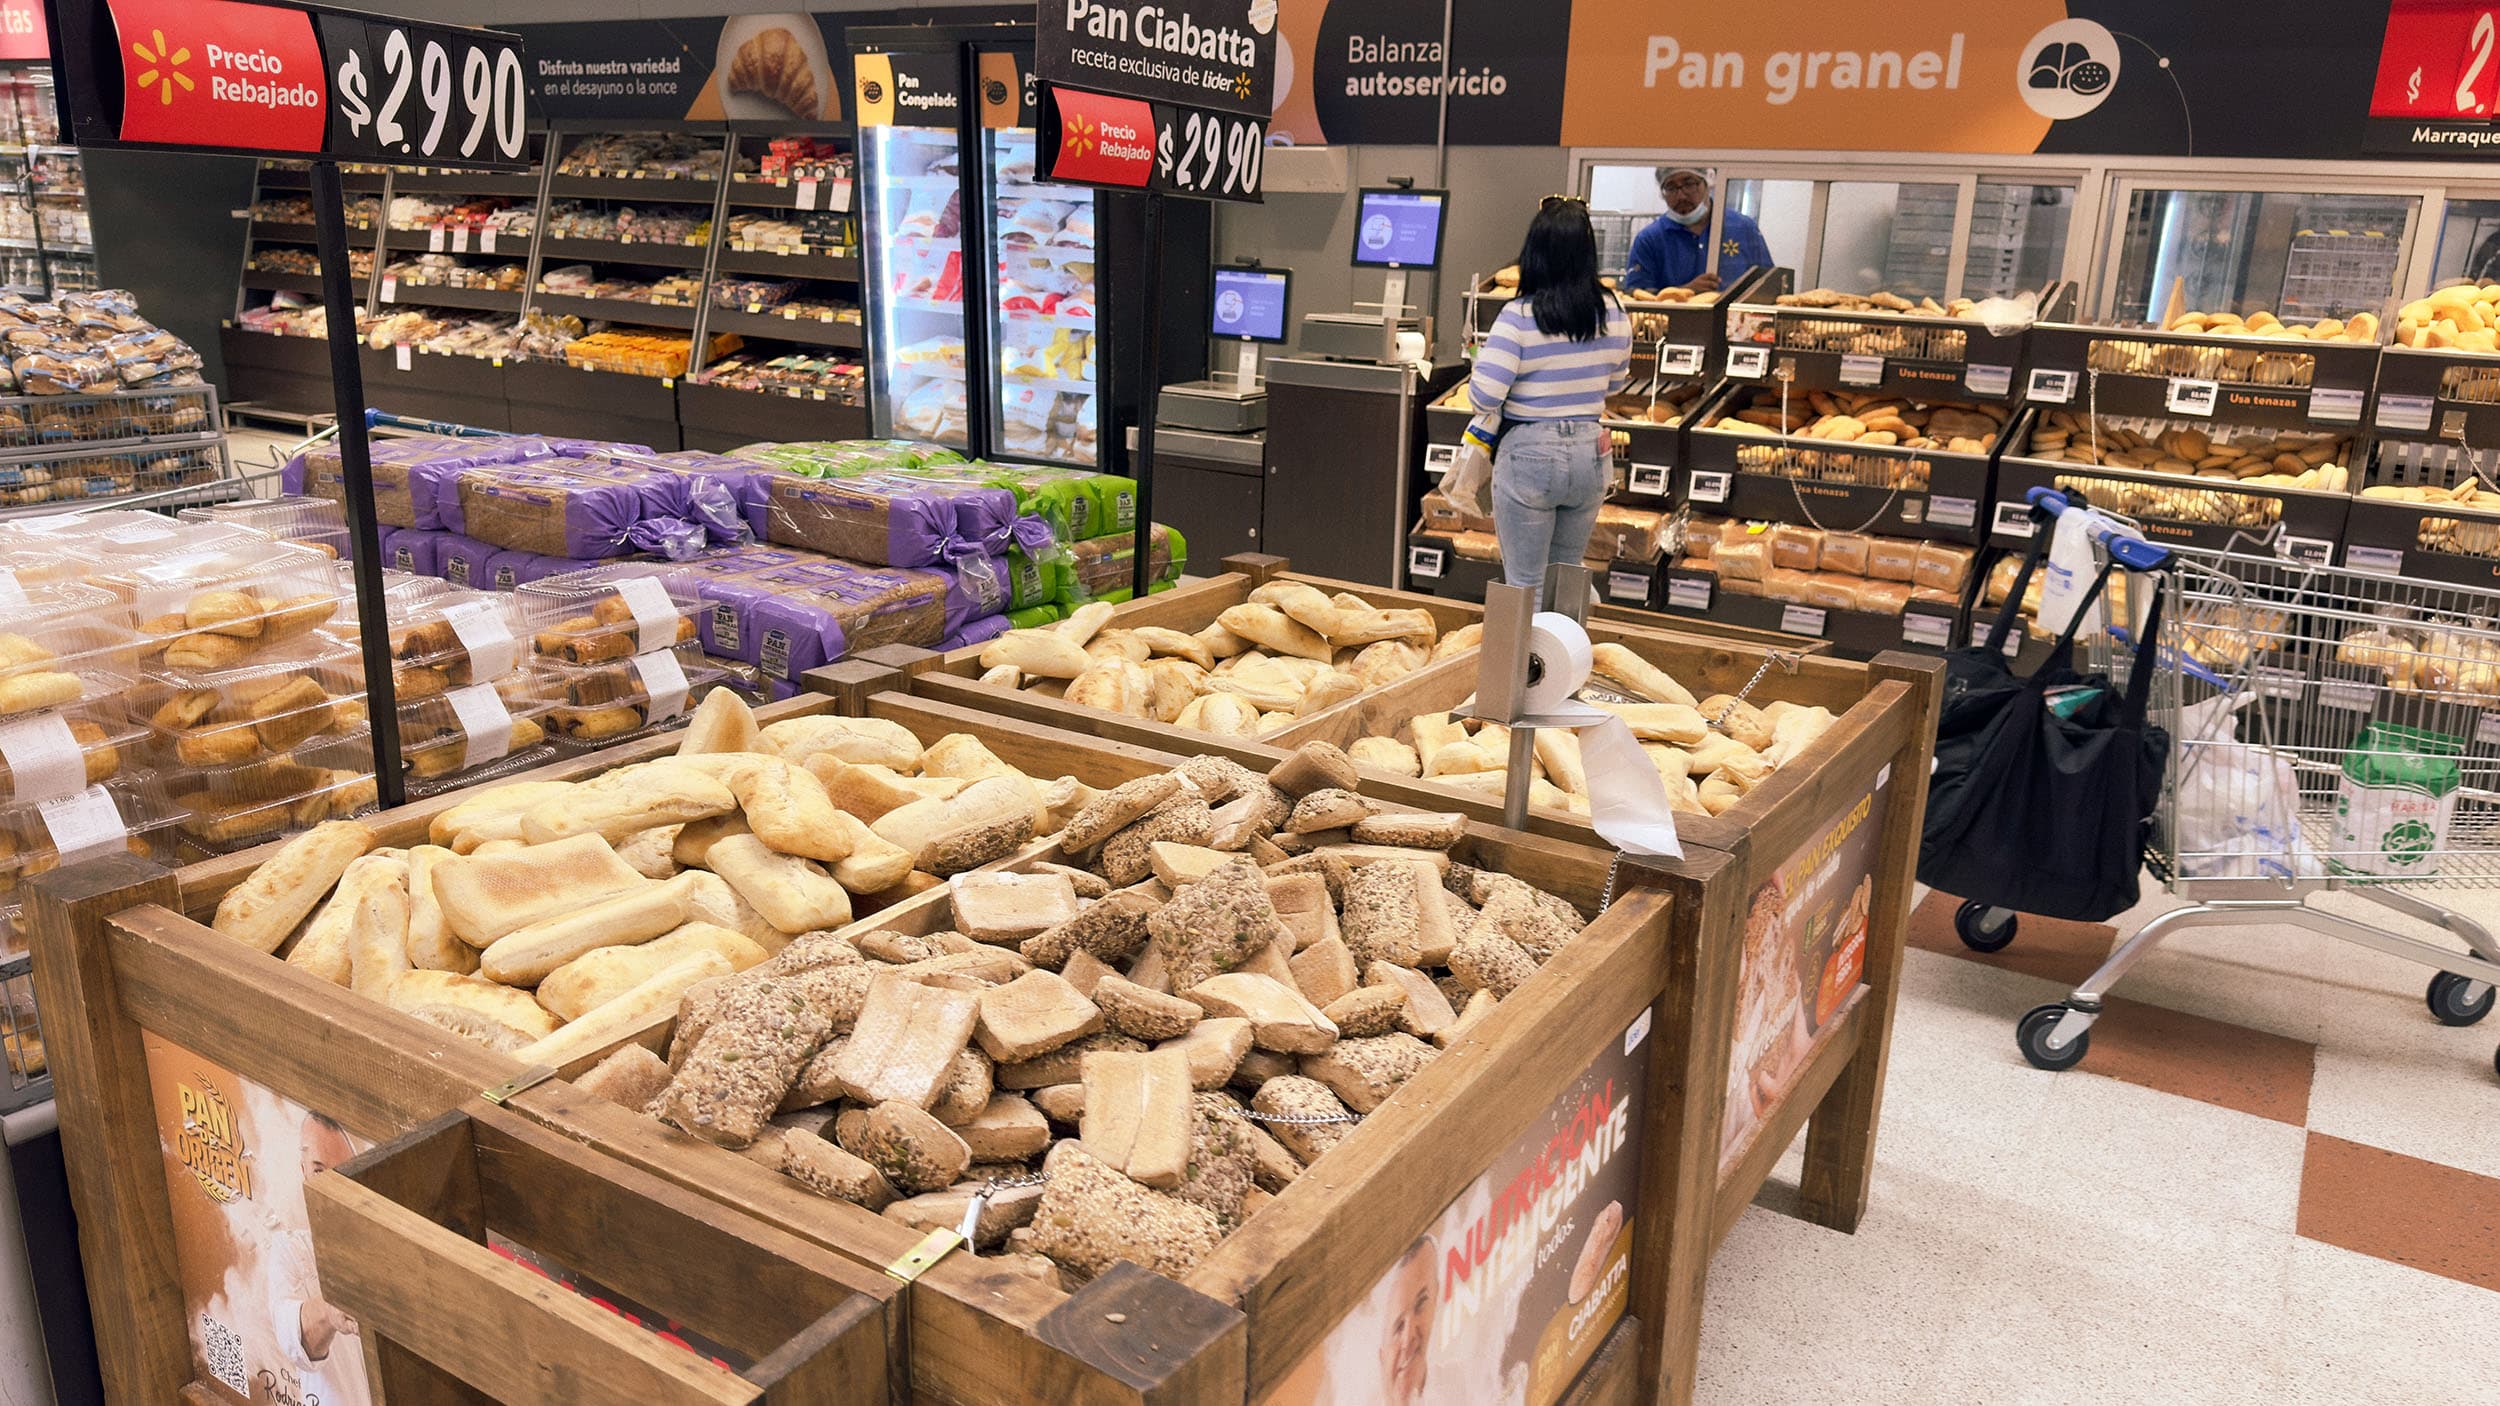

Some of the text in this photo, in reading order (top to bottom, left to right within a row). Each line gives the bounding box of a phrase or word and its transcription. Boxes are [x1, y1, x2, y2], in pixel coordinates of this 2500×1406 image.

[1066, 0, 1256, 67] Pan Ciabatta
[1348, 35, 1442, 63] Balanza
[206, 44, 282, 74] Precio
[539, 57, 681, 75] Disfruta nuestra variedad
[1071, 47, 1117, 70] receta
[1119, 58, 1180, 83] exclusiva
[1182, 65, 1199, 86] de
[1644, 32, 1965, 105] Pan granel
[212, 76, 318, 108] Rebajado
[338, 28, 525, 158] $2.990
[545, 79, 678, 99] en el desayuno o la once
[898, 73, 919, 88] Pan
[1345, 67, 1507, 96] autoservicio
[1100, 122, 1136, 141] Precio
[1100, 141, 1151, 161] Rebajado
[1158, 112, 1262, 195] $2.990
[2229, 393, 2297, 408] Usa tenazas
[766, 637, 786, 650] PAN
[1797, 843, 1820, 887] PAN
[1822, 793, 1872, 860] EXQUISITO
[176, 1082, 233, 1149] PAN
[175, 1126, 253, 1201] ORIGEN
[1444, 1077, 1613, 1303] NUTRICIÓN
[1537, 1216, 1576, 1270] todos
[1567, 1252, 1628, 1341] CIABATTA
